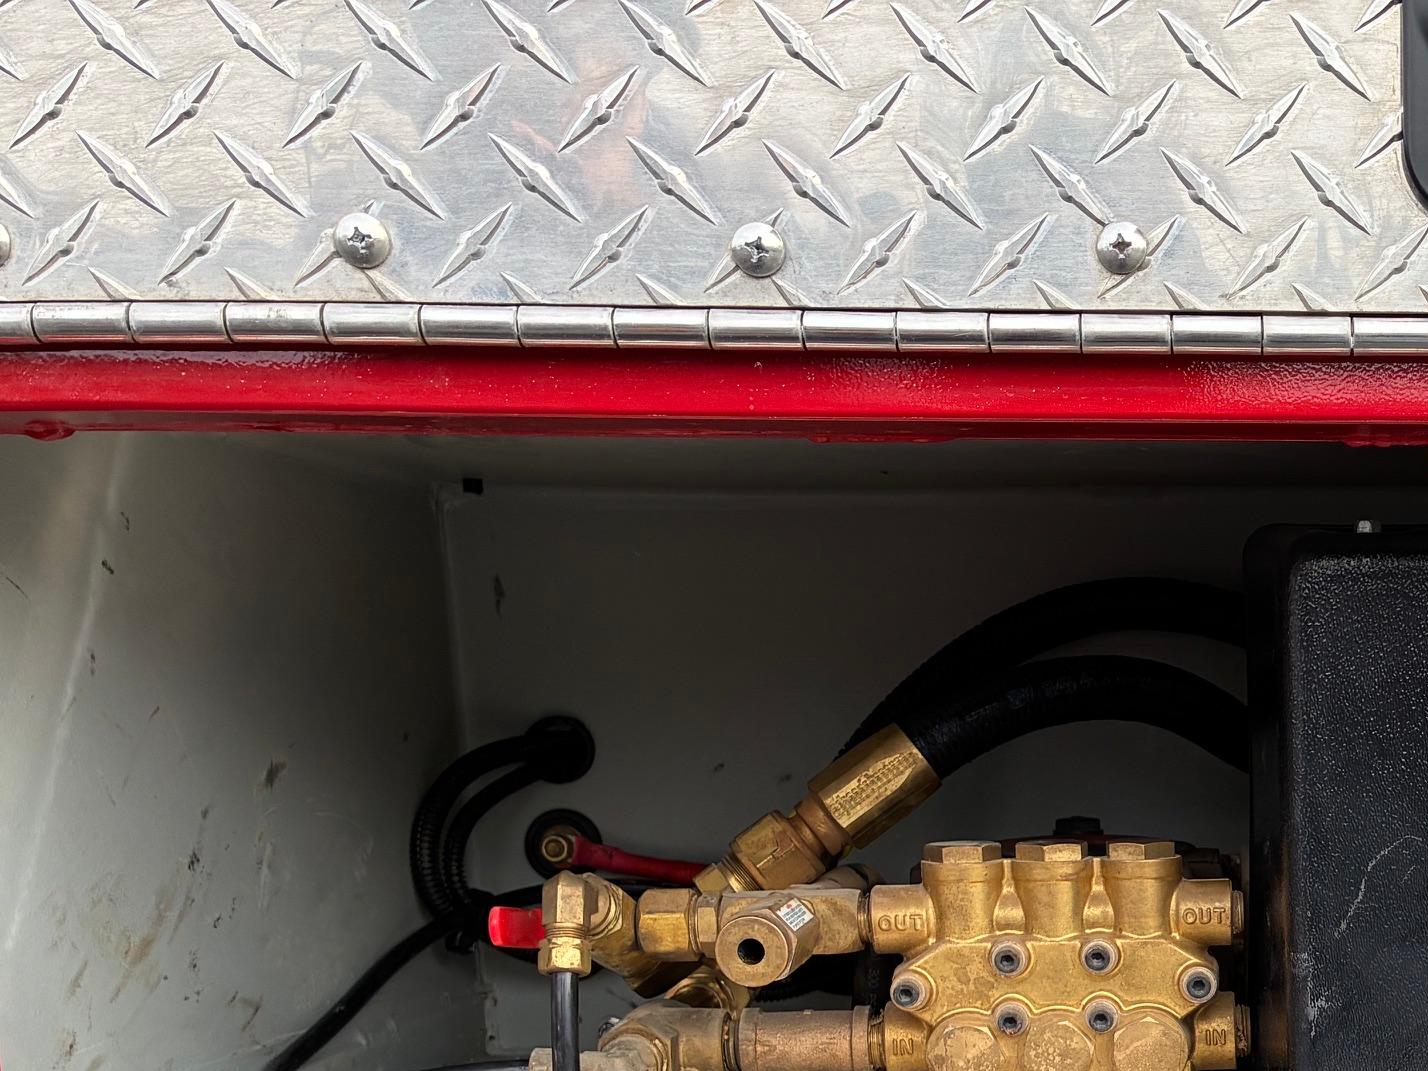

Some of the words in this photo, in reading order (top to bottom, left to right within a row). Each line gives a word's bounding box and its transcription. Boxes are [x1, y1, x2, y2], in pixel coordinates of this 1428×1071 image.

[878, 914, 923, 931] OUT
[1182, 907, 1226, 925] OUT
[1205, 1028, 1226, 1046] IN
[892, 1037, 914, 1056] IN
